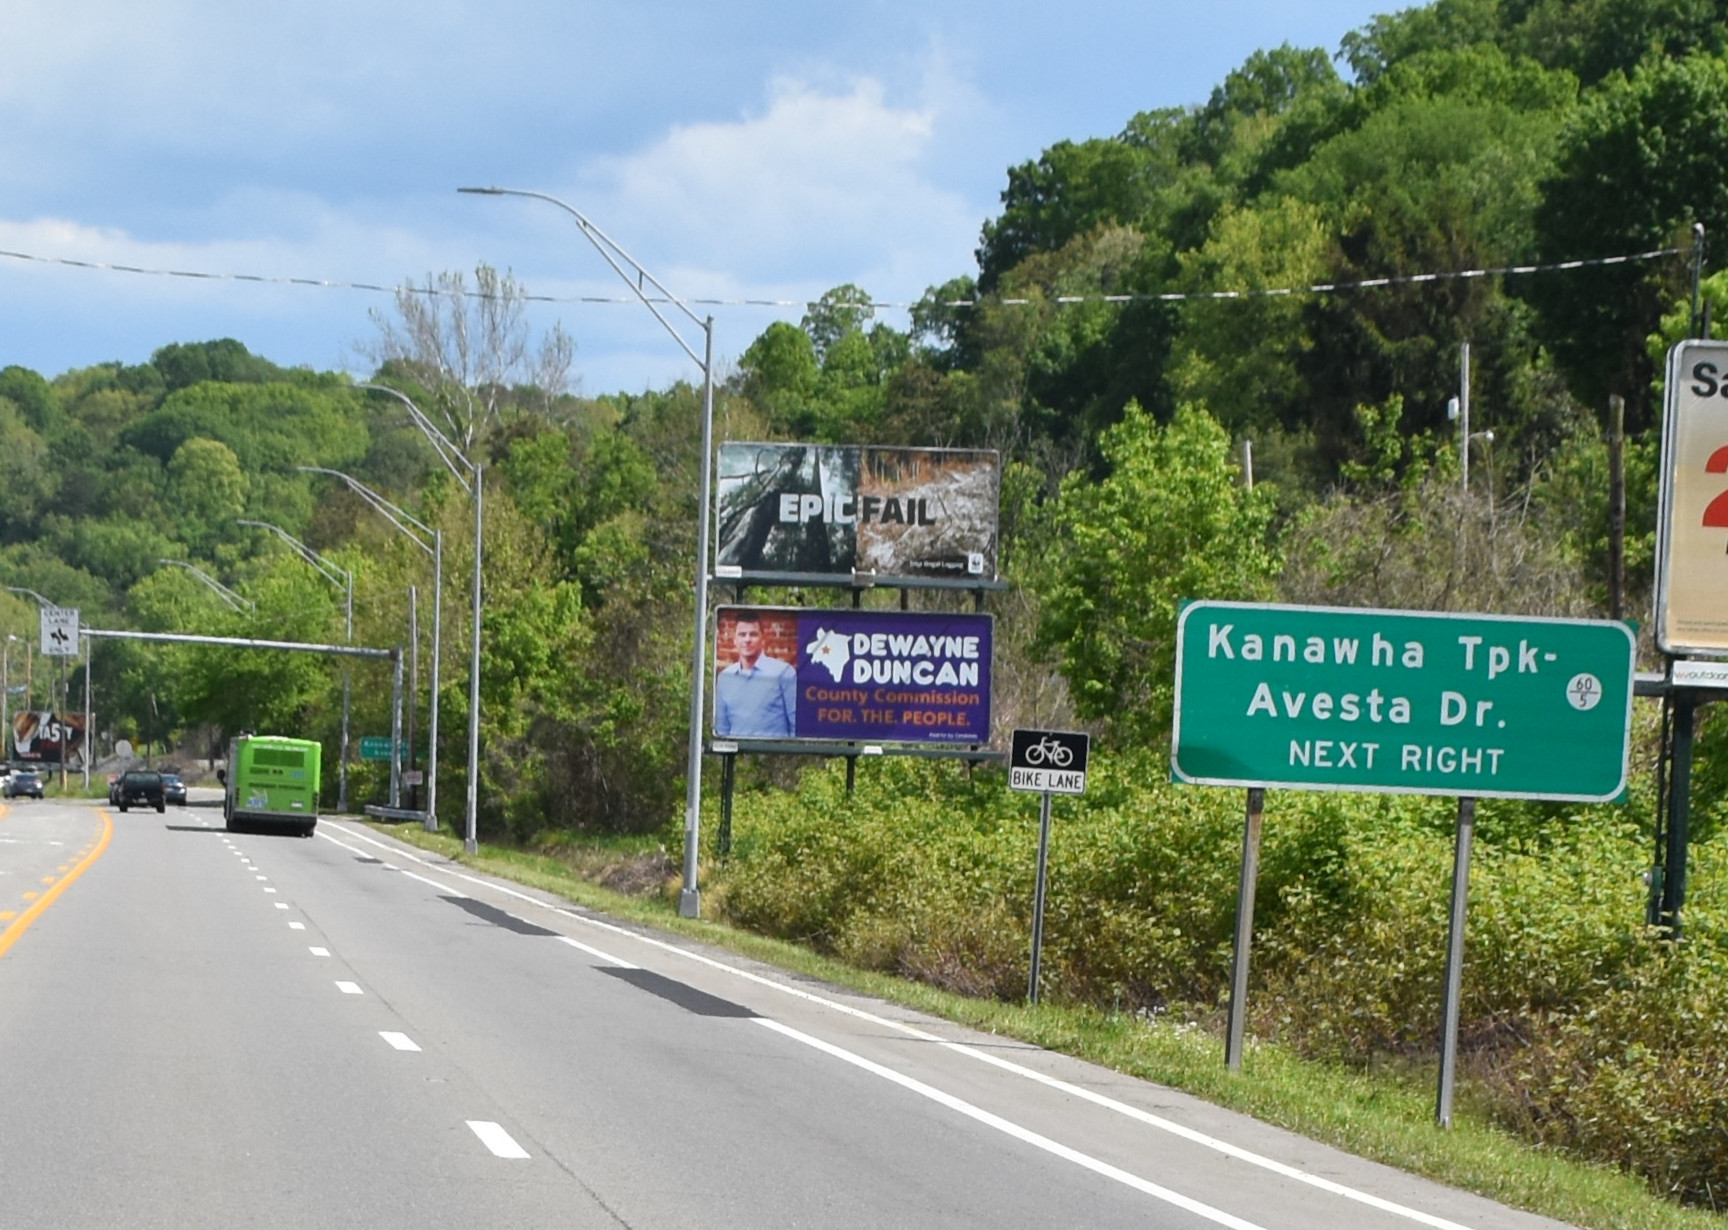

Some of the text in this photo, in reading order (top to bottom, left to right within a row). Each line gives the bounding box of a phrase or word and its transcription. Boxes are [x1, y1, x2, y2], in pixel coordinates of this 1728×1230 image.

[779, 493, 936, 526] EPIC FAIL
[853, 633, 980, 659] DEWAYNE
[1208, 624, 1557, 679] Kanawha Tpk-
[853, 659, 979, 687] DUNCAN
[1576, 677, 1592, 692] 60
[805, 686, 980, 705] County Commission
[1247, 682, 1506, 728] Avesta Dr.
[1579, 694, 1587, 708] 5
[818, 708, 970, 727] FOR. THE. PEOPLE.
[1289, 740, 1505, 775] NEXT RIGHT
[1013, 771, 1082, 789] BIKE LANE
